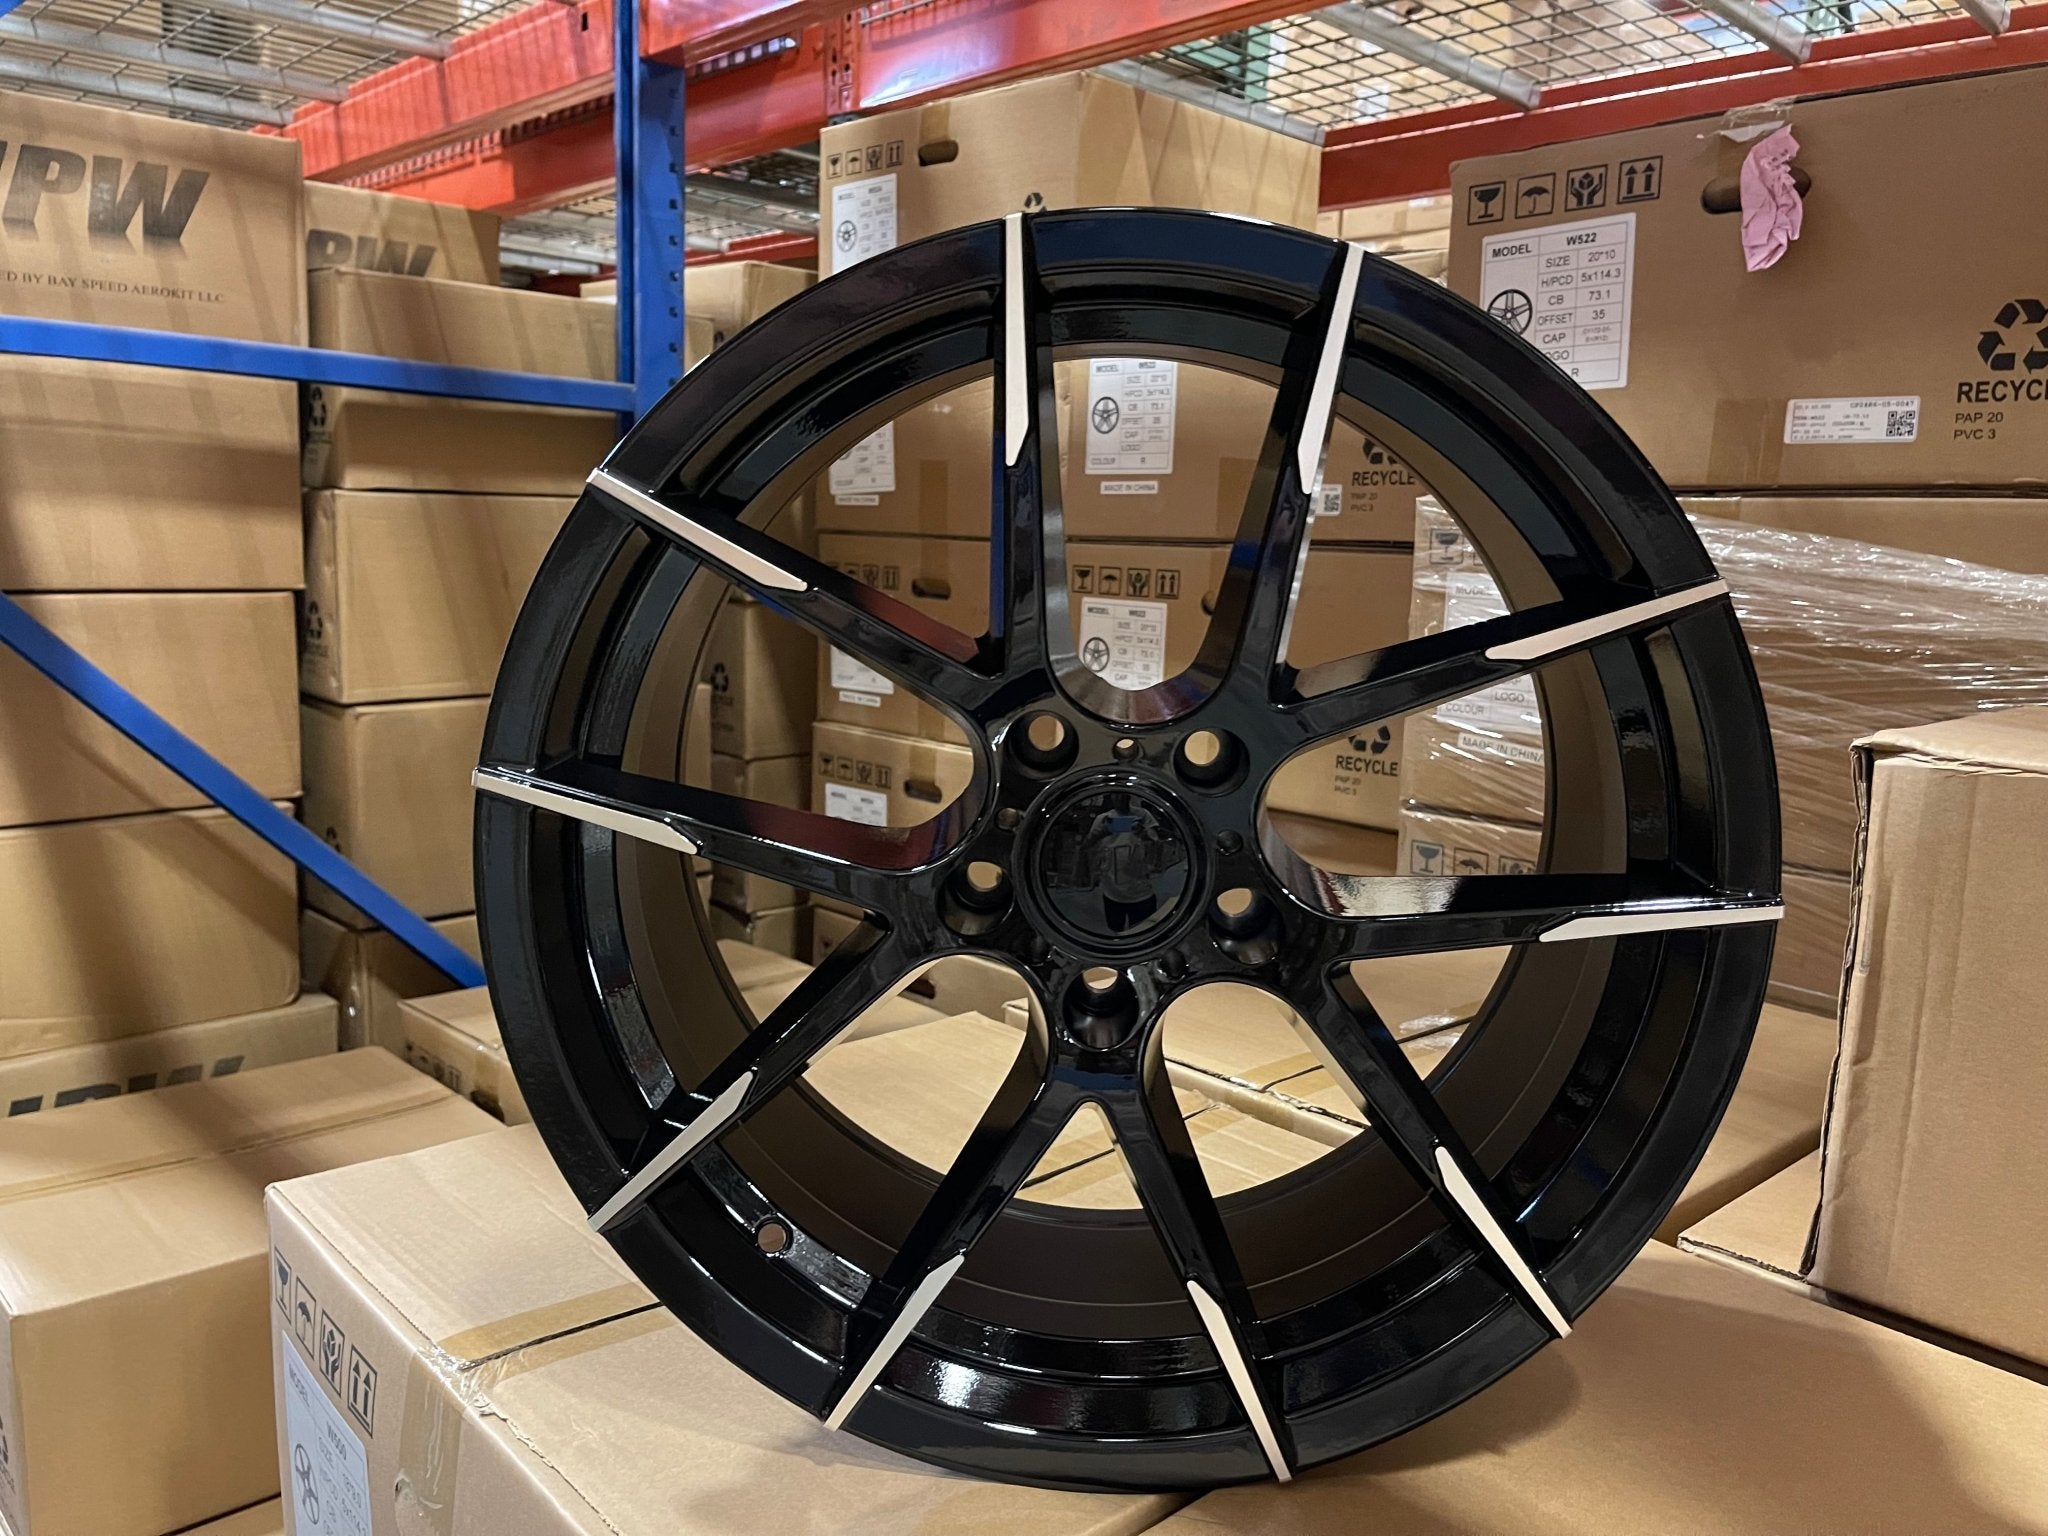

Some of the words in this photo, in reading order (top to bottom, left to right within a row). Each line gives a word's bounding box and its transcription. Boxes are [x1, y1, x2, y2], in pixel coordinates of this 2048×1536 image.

[0, 141, 210, 243] PW
[1566, 232, 1597, 246] W522
[1492, 244, 1532, 258] MODEL
[1545, 255, 1571, 268] SIZE
[1541, 274, 1574, 288] H/PCD
[1580, 268, 1621, 283] 5x114.3
[22, 272, 44, 285] BY
[47, 275, 79, 289] BAY
[82, 279, 129, 293] SPEED
[131, 285, 194, 300] AEROKIT
[198, 291, 225, 303] LLC
[1547, 294, 1565, 306] CB
[1588, 289, 1611, 301] 73.1
[1537, 312, 1574, 326] OFFSET
[1592, 309, 1606, 320] 35
[1542, 332, 1567, 345] CAP
[1571, 368, 1580, 377] R
[1957, 379, 2048, 403] RECYC
[1955, 412, 1983, 425] PAP
[1987, 411, 2004, 423] 20
[1953, 428, 1984, 440] PVC
[1988, 428, 1996, 439] 3
[1351, 470, 1416, 487] RECYCLE
[1494, 691, 1525, 703] LOGO
[1445, 702, 1485, 715] COLOUR
[1335, 754, 1399, 777] RECYCLE
